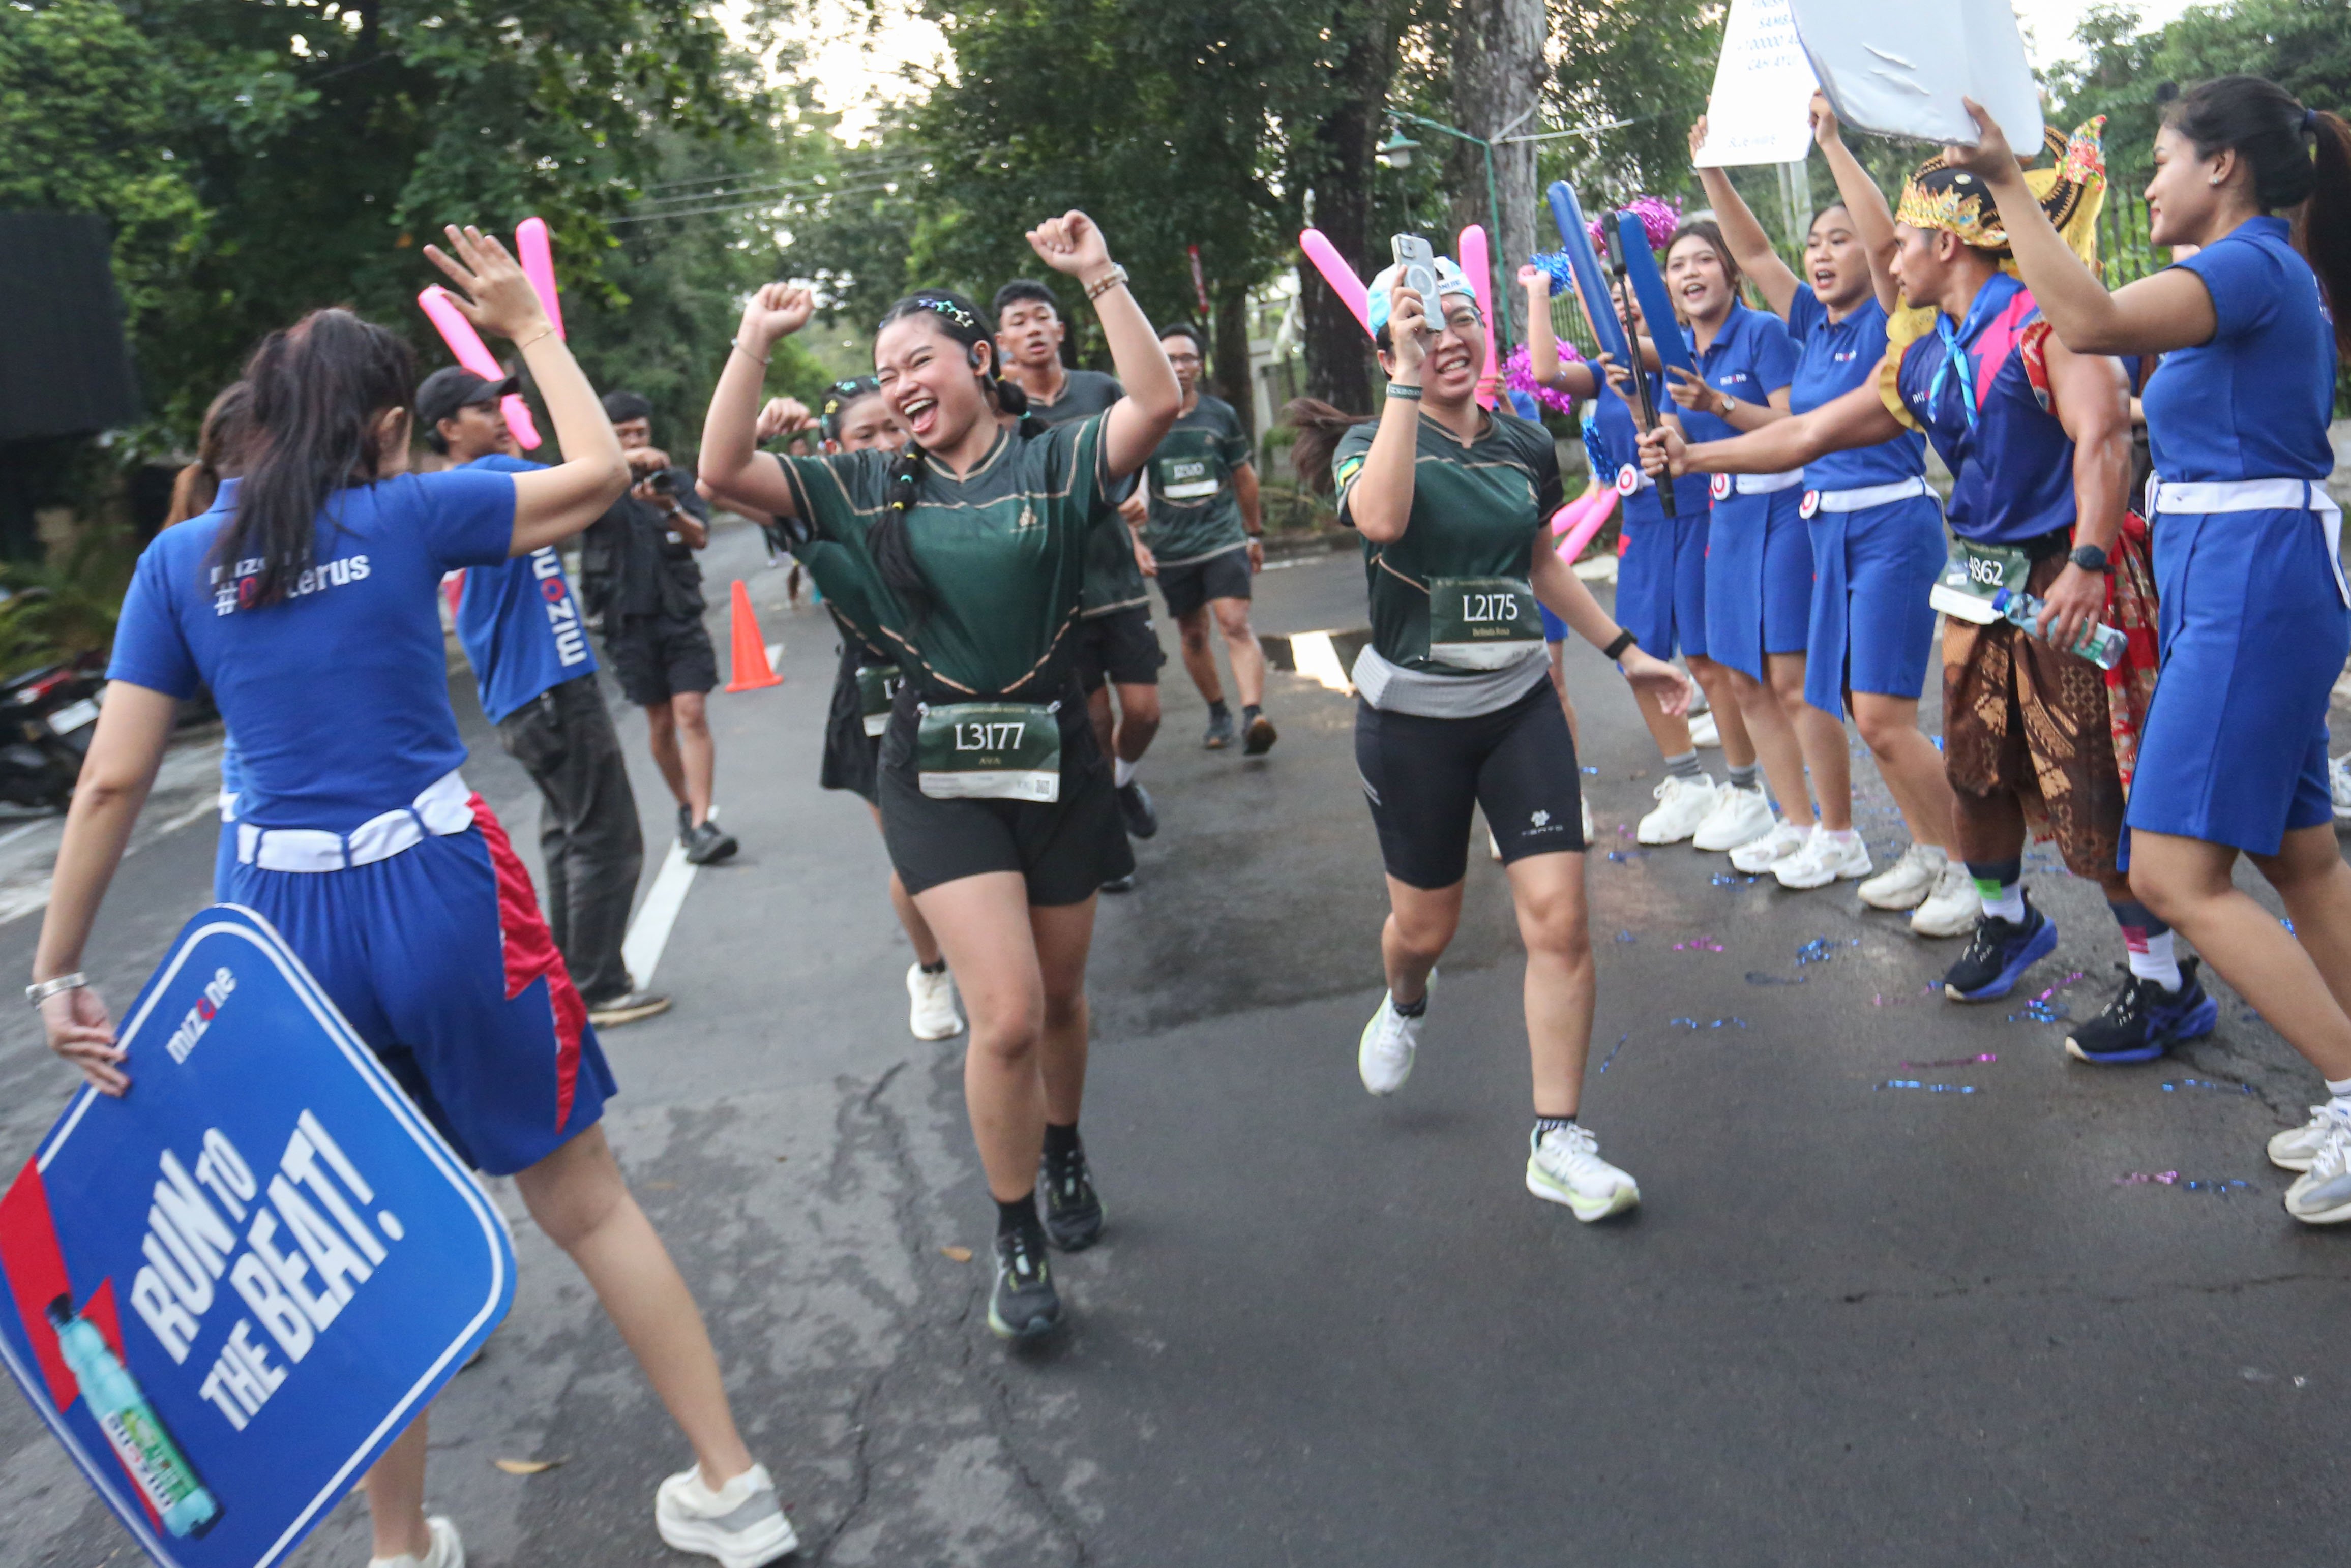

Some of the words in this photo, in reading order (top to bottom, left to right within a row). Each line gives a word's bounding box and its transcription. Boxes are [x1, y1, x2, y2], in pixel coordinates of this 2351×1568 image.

[1463, 593, 1518, 622] L2175
[955, 722, 1026, 750] L3177
[166, 966, 236, 1064] mizone
[131, 1149, 237, 1364] RUN
[195, 1128, 257, 1223] TO
[230, 1109, 404, 1364] BEAT!
[200, 1318, 288, 1431] THE
